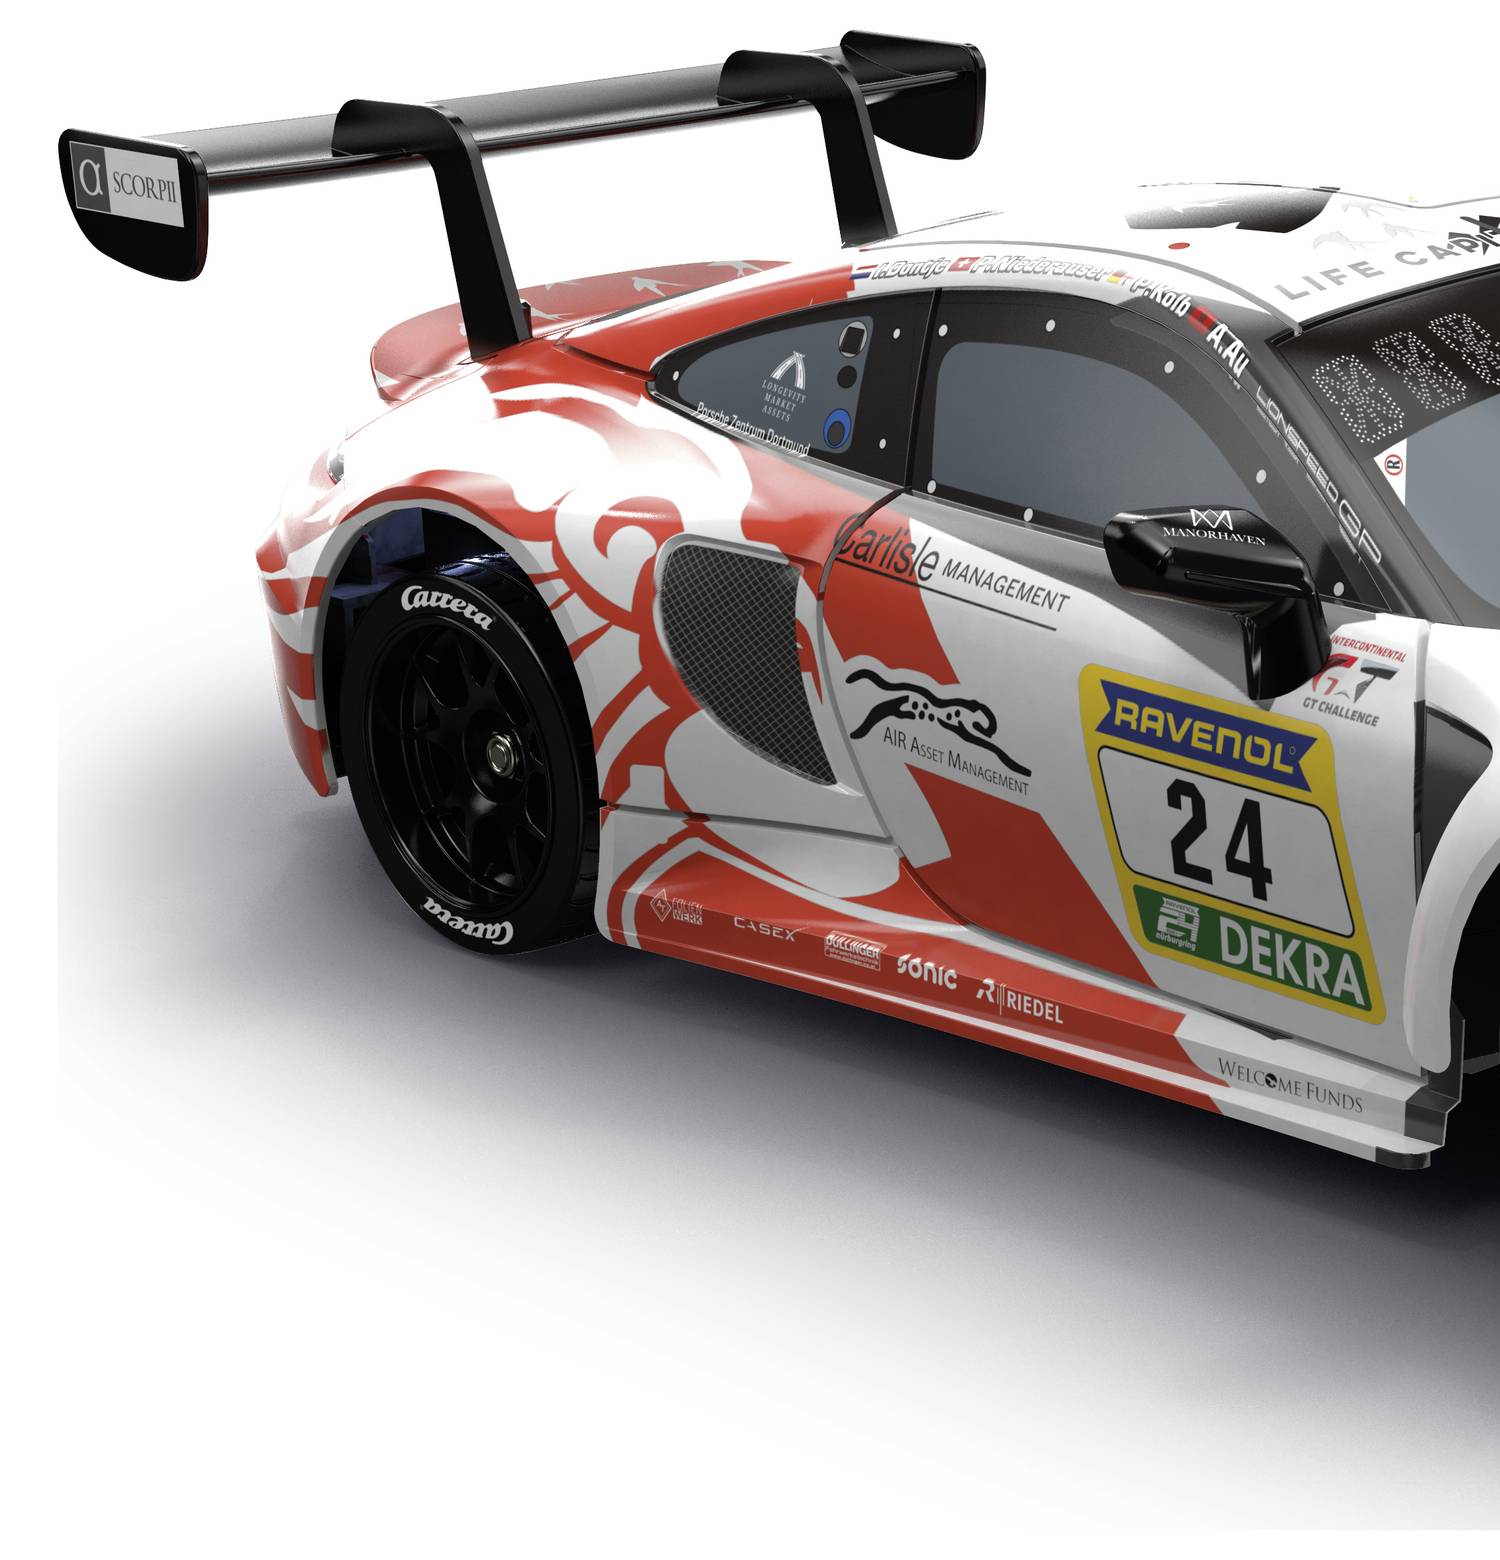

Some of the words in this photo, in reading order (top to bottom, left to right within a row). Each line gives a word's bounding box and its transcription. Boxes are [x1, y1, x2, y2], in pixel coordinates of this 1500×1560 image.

[113, 171, 177, 203] SCORPII
[1274, 260, 1385, 300] LIFE
[1206, 323, 1250, 378] A.Au
[761, 379, 807, 404] LONGEVITY
[764, 392, 796, 412] MARKET
[697, 401, 729, 426] Porsche
[729, 414, 766, 441] Zentrum
[766, 428, 811, 457] Dortmund
[761, 405, 791, 422] ASSETS
[1255, 385, 1339, 503] LIONSPEED
[1338, 499, 1382, 564] GP
[1163, 526, 1266, 547] MANORHAVEN
[834, 511, 940, 582] Carlisle
[942, 558, 1071, 613] MANAGEMENT
[400, 585, 494, 631] Carrera
[1331, 635, 1407, 663] INTERCONTINENTAL
[1303, 697, 1319, 710] GT
[1318, 701, 1380, 727] CHALLENGE
[1114, 698, 1294, 774] RAVENOL
[883, 727, 907, 751] AIR
[910, 737, 944, 763] ASSET
[948, 751, 1029, 797] MANAGEMENT
[1166, 778, 1273, 901] 24
[423, 896, 514, 945] Carrera
[733, 916, 807, 942] CASEX
[1219, 916, 1365, 1005] DEKRA
[1007, 990, 1064, 1025] RIEDEL
[1306, 1082, 1364, 1113] FUNDS
